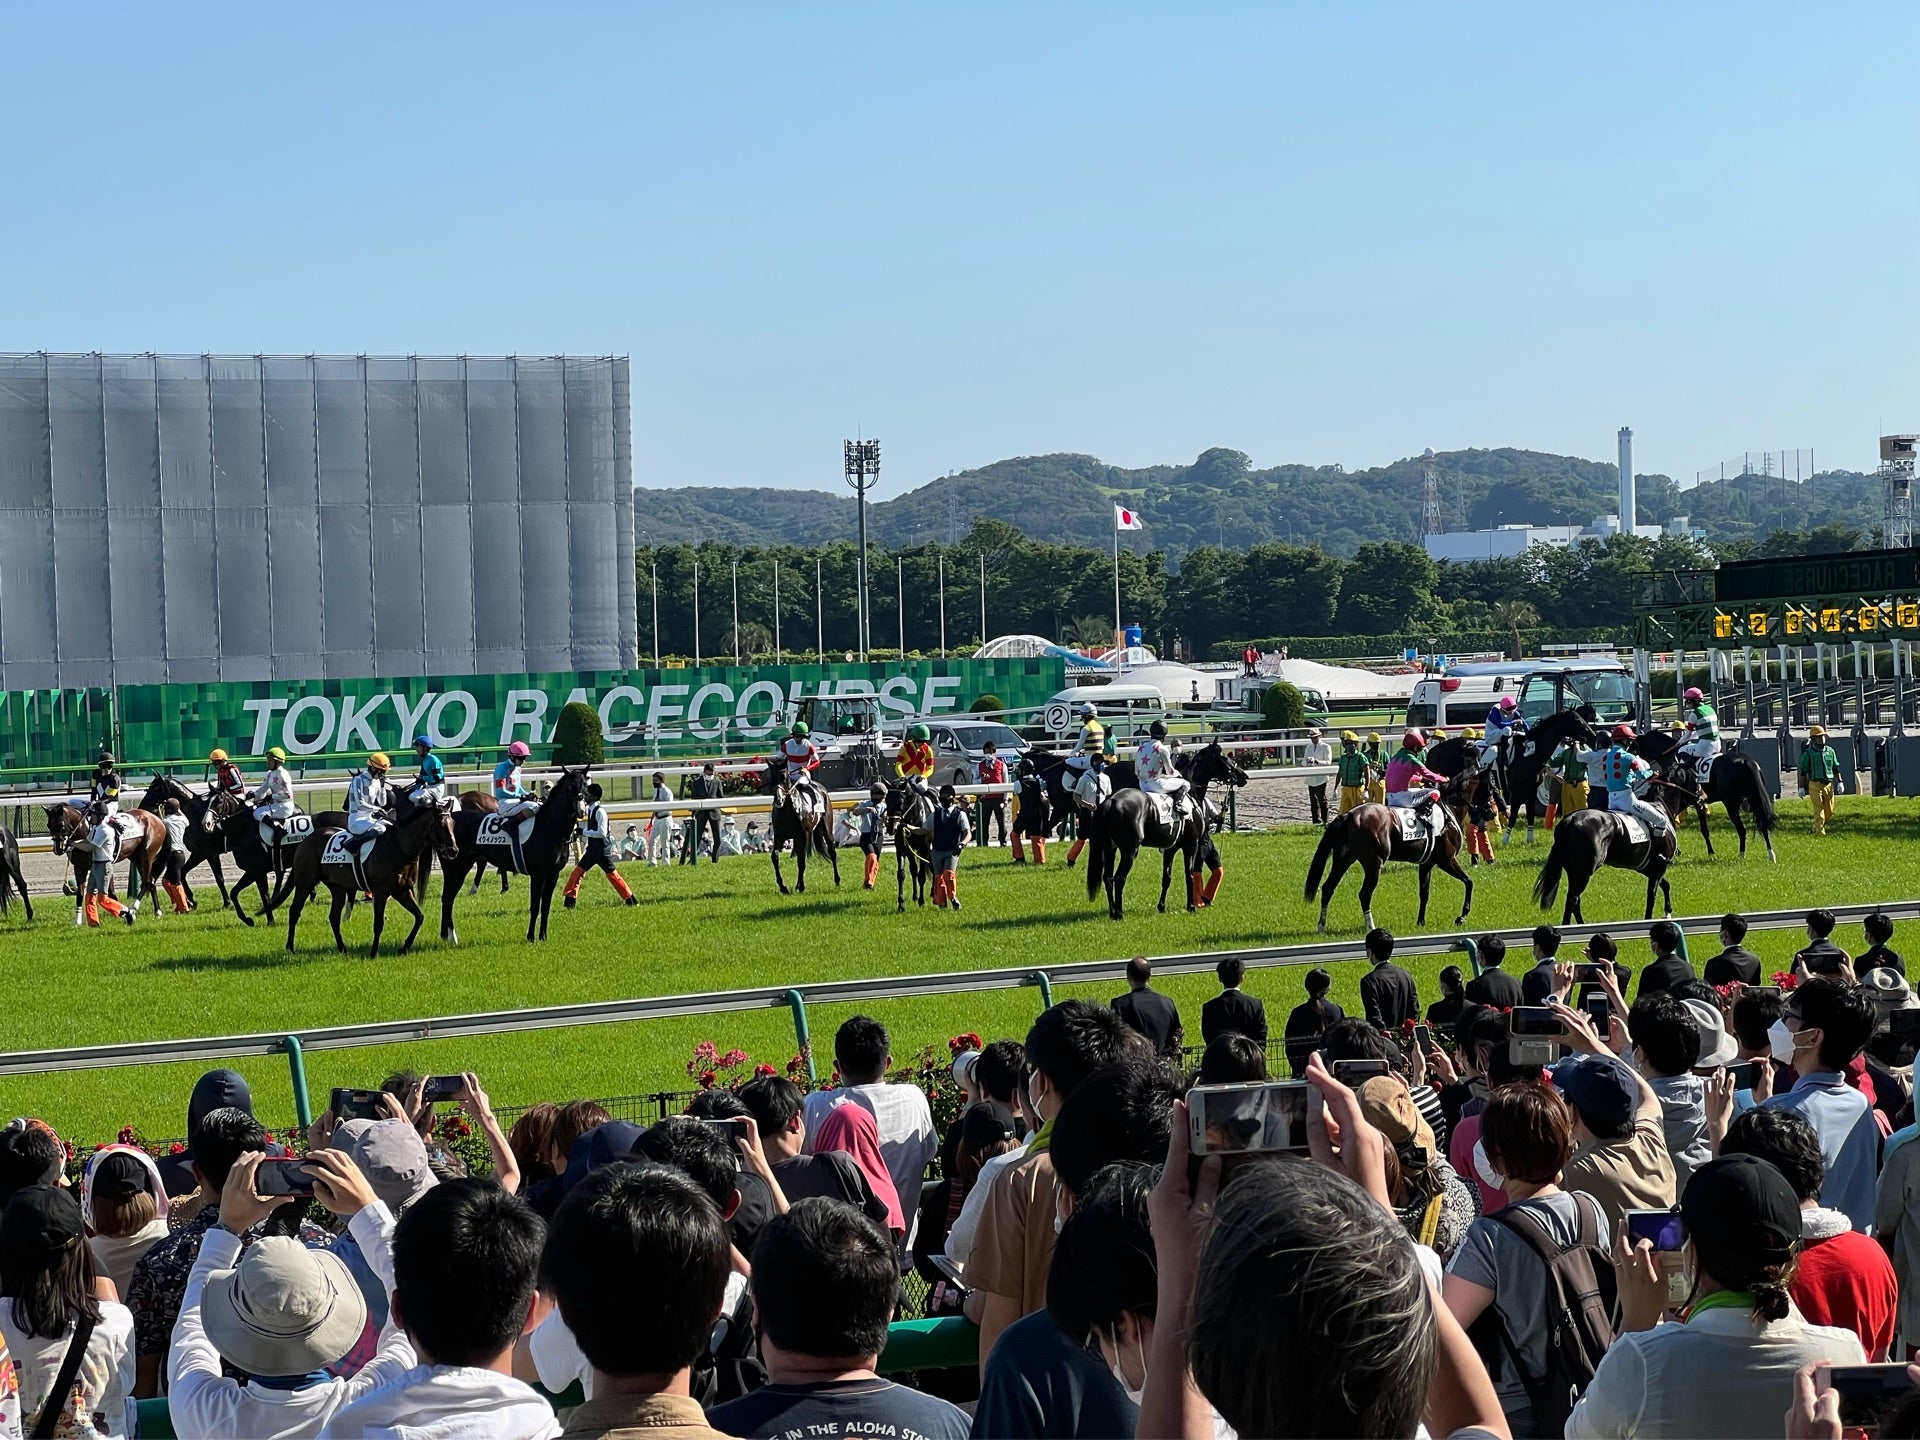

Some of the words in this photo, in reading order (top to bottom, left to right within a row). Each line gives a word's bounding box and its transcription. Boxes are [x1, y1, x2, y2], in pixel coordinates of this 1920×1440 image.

[1720, 617, 1726, 635] 1
[1754, 615, 1763, 633] 2
[1789, 614, 1799, 632] 3
[1827, 611, 1836, 629] 4
[1865, 609, 1875, 627] 5
[1904, 607, 1914, 625] 6
[1419, 686, 1426, 698] A
[242, 690, 478, 756] TOKYO
[290, 817, 310, 834] 10
[481, 816, 502, 834] 18
[326, 834, 348, 853] 13
[785, 1428, 803, 1440] IN
[807, 1422, 839, 1436] THE
[845, 1421, 896, 1437] ALOHA
[901, 1428, 930, 1440] STA
